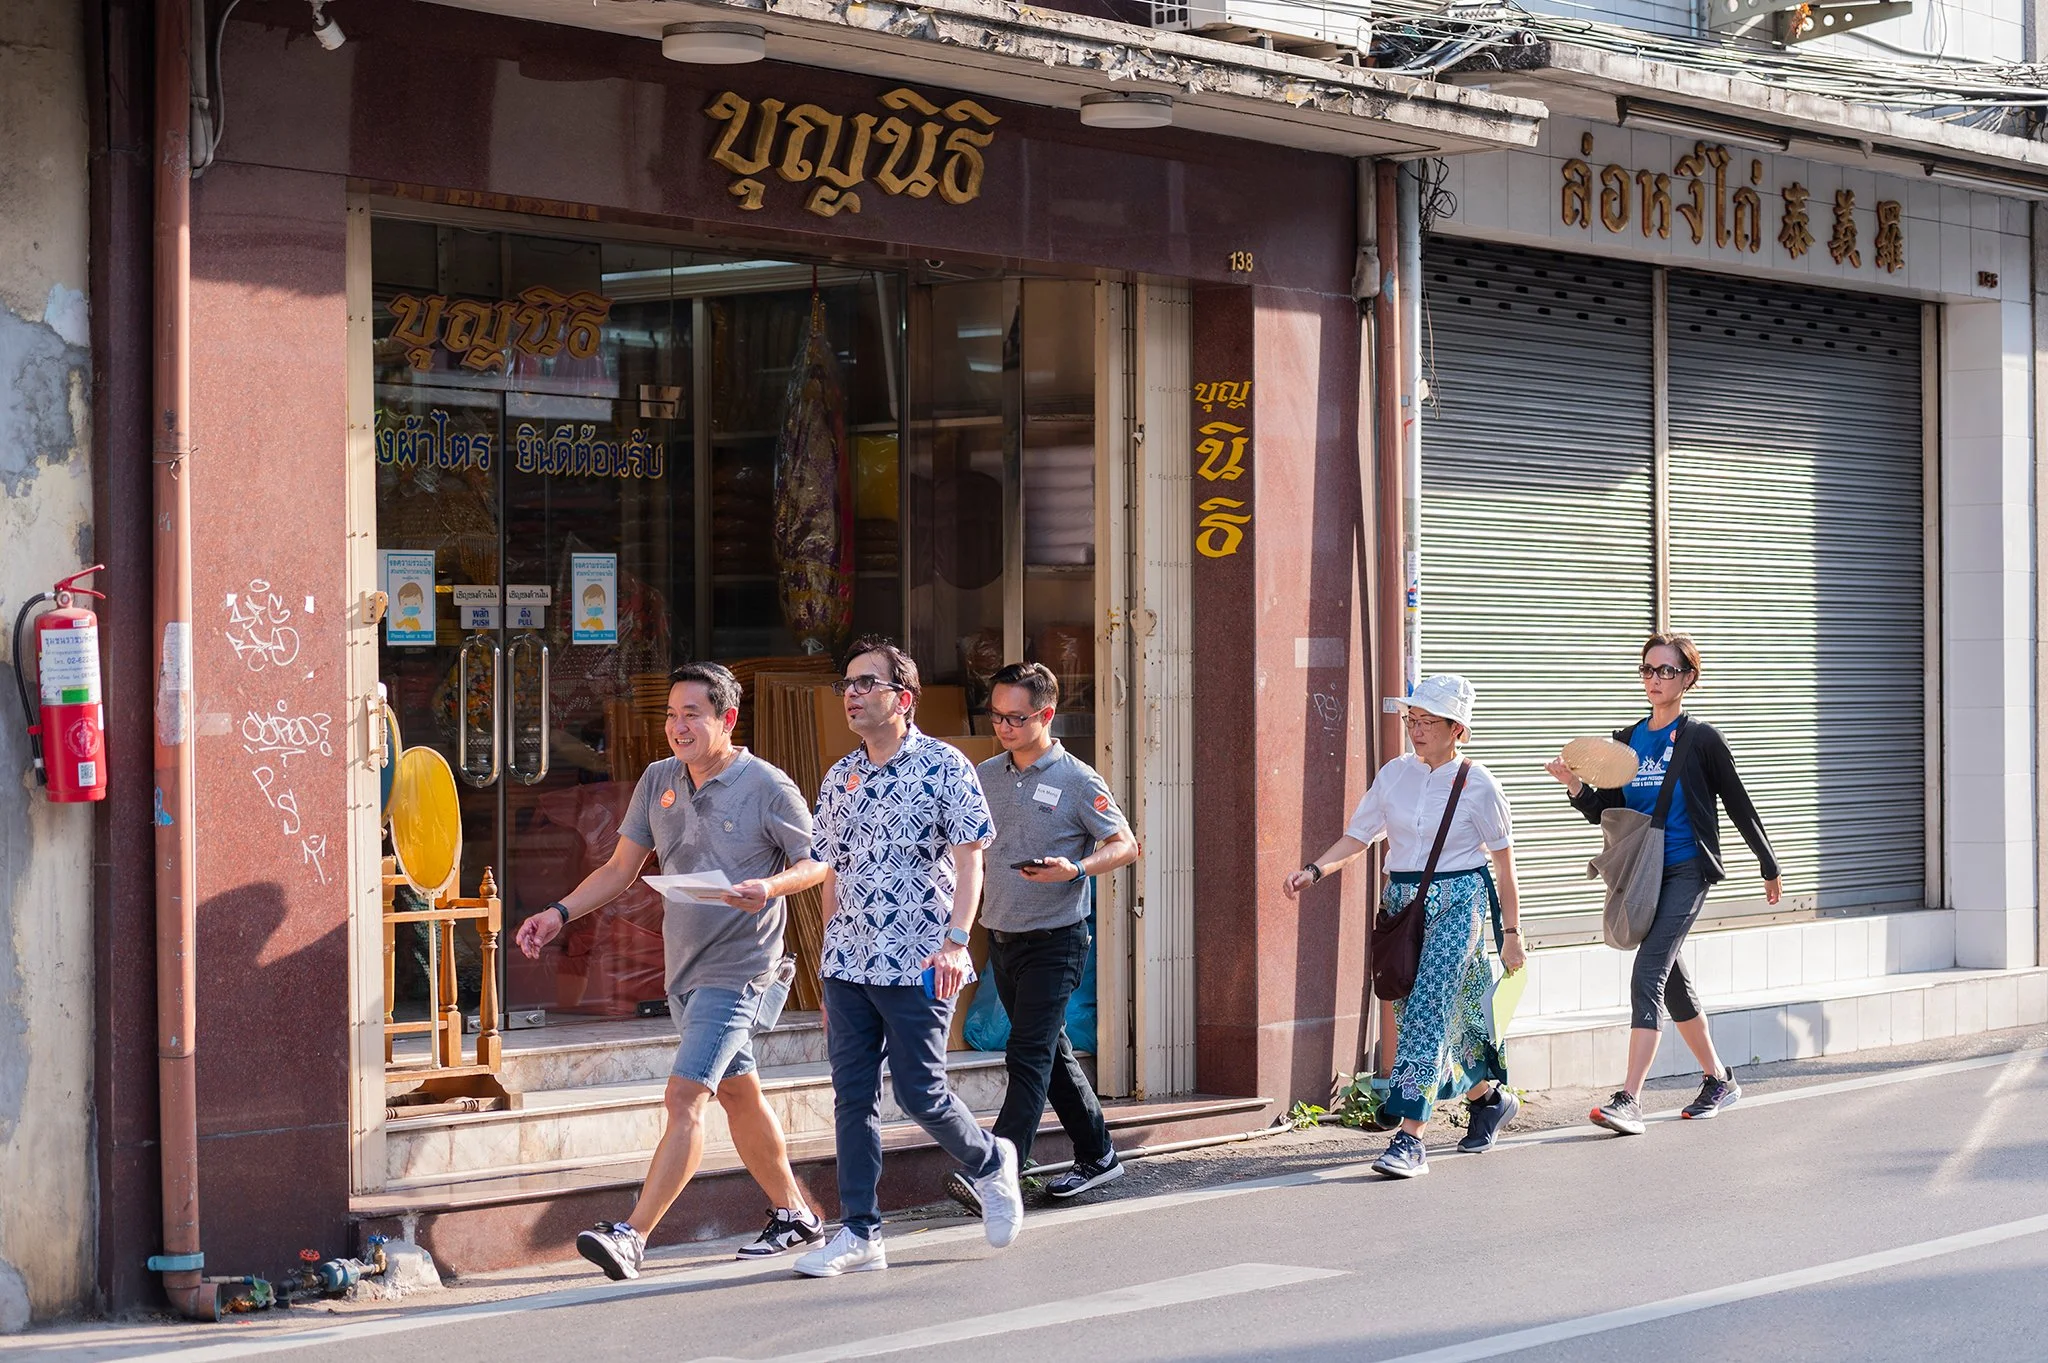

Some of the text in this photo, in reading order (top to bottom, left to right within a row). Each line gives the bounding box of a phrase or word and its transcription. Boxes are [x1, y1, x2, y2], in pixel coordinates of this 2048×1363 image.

[704, 88, 1002, 218] บุญนิธิ
[1229, 251, 1253, 272] 138
[384, 285, 615, 372] บุญนิธิ
[515, 423, 663, 479] ยินดีต้อนรับ
[472, 619, 490, 627] PUSH
[520, 607, 531, 618] ดึง
